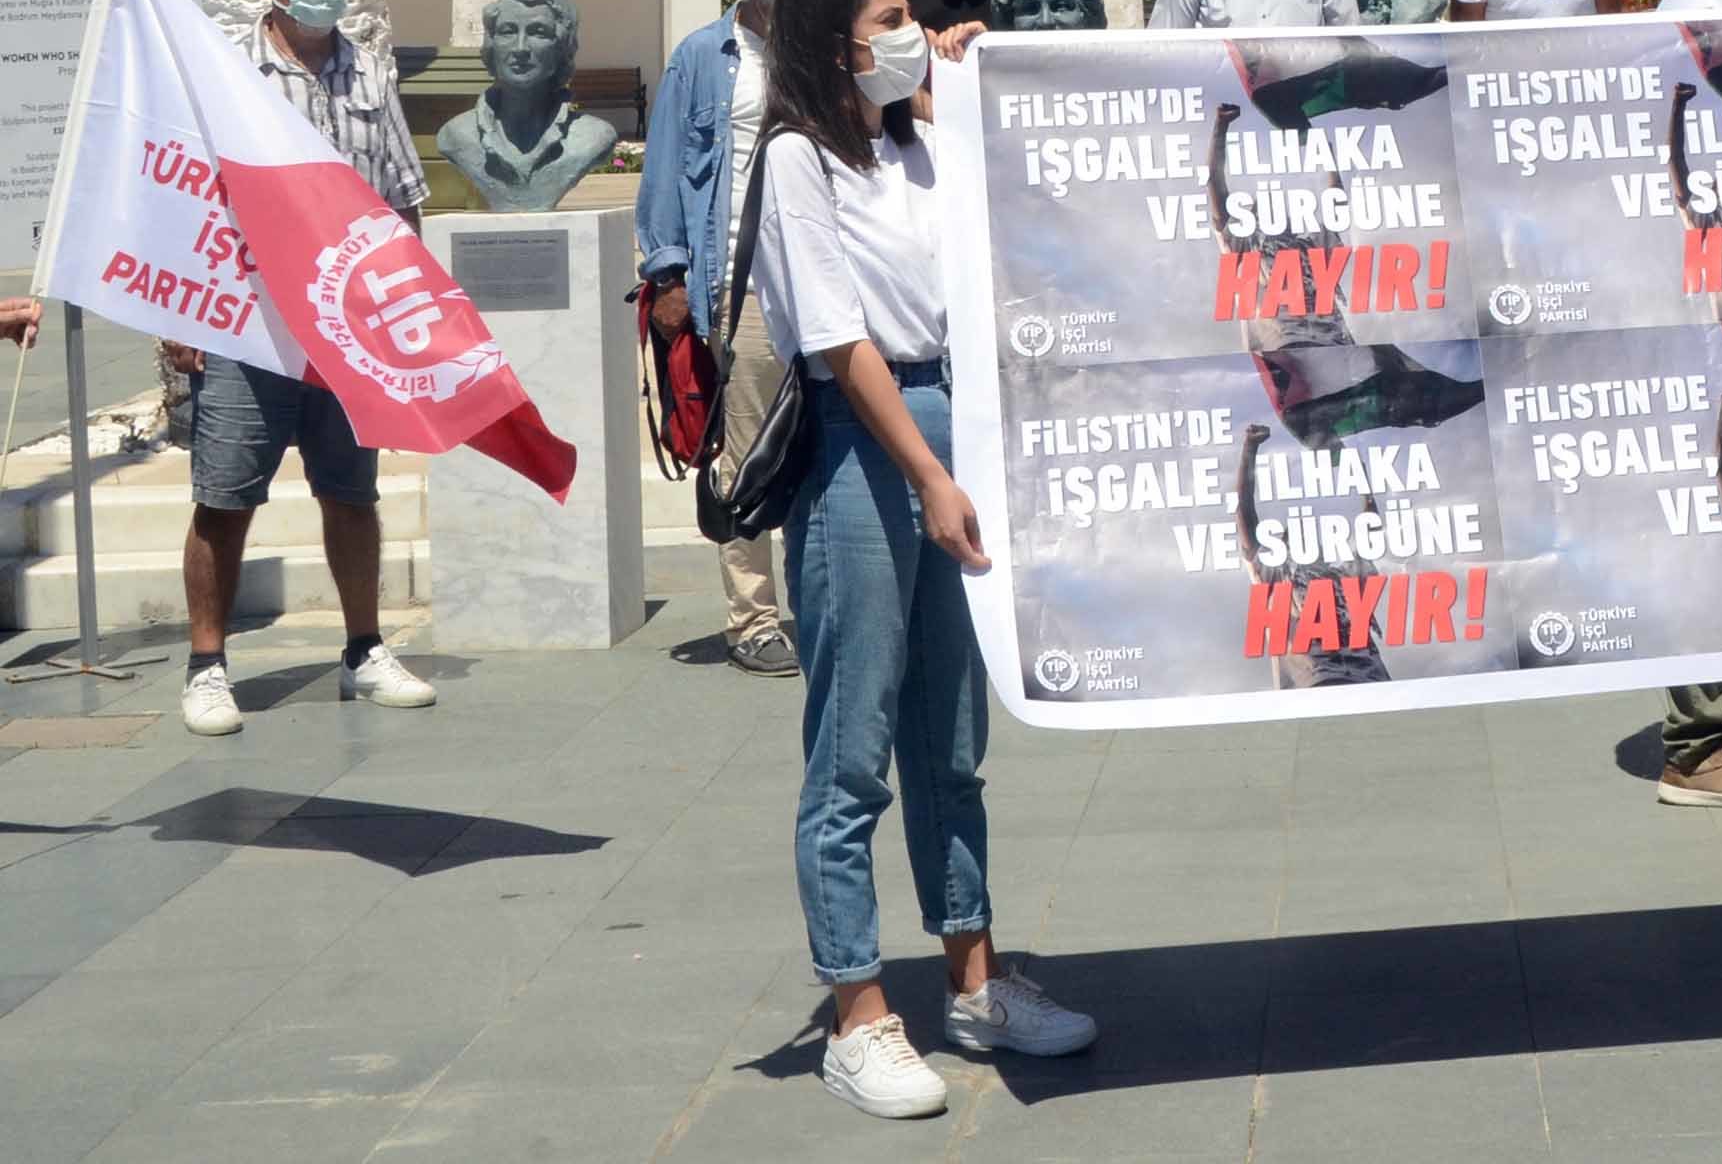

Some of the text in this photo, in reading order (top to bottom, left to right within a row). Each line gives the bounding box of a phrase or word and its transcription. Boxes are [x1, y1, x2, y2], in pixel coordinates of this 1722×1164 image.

[1, 53, 38, 63] WOMEN
[41, 51, 65, 61] WHO
[1492, 112, 1671, 176] İŞGALE,
[1024, 124, 1404, 198] İŞGALE, İLHAKA
[1611, 172, 1674, 218] VE
[1146, 177, 1445, 241] VE SÜRGÜNE
[193, 211, 259, 282] İŞÇ
[1214, 240, 1450, 322] HAYIR!
[1536, 280, 1591, 295] TÜRKİYE
[101, 250, 259, 336] PARTİSİ
[1537, 294, 1562, 311] İŞÇİ
[1060, 311, 1117, 325] TÜRKİYE
[1539, 308, 1588, 323] PARTİSİ
[1060, 325, 1086, 342] İŞÇİ
[1061, 339, 1111, 355] PARTİSİ
[1532, 423, 1719, 494] İŞGALE,
[1048, 443, 1440, 528] İŞGALE, İLHAKA
[1656, 485, 1722, 536] VE
[1173, 499, 1483, 573] VE SÜRGÜNE
[1243, 567, 1489, 659] HAYIR!
[1579, 605, 1637, 621] TÜRKİYE
[1580, 622, 1606, 639] İŞÇİ
[1582, 635, 1632, 652] PARTİSİ
[1085, 646, 1144, 661] TÜRKİYE
[1086, 661, 1112, 678] İŞÇİ
[1087, 676, 1138, 691] PARTİSİ
